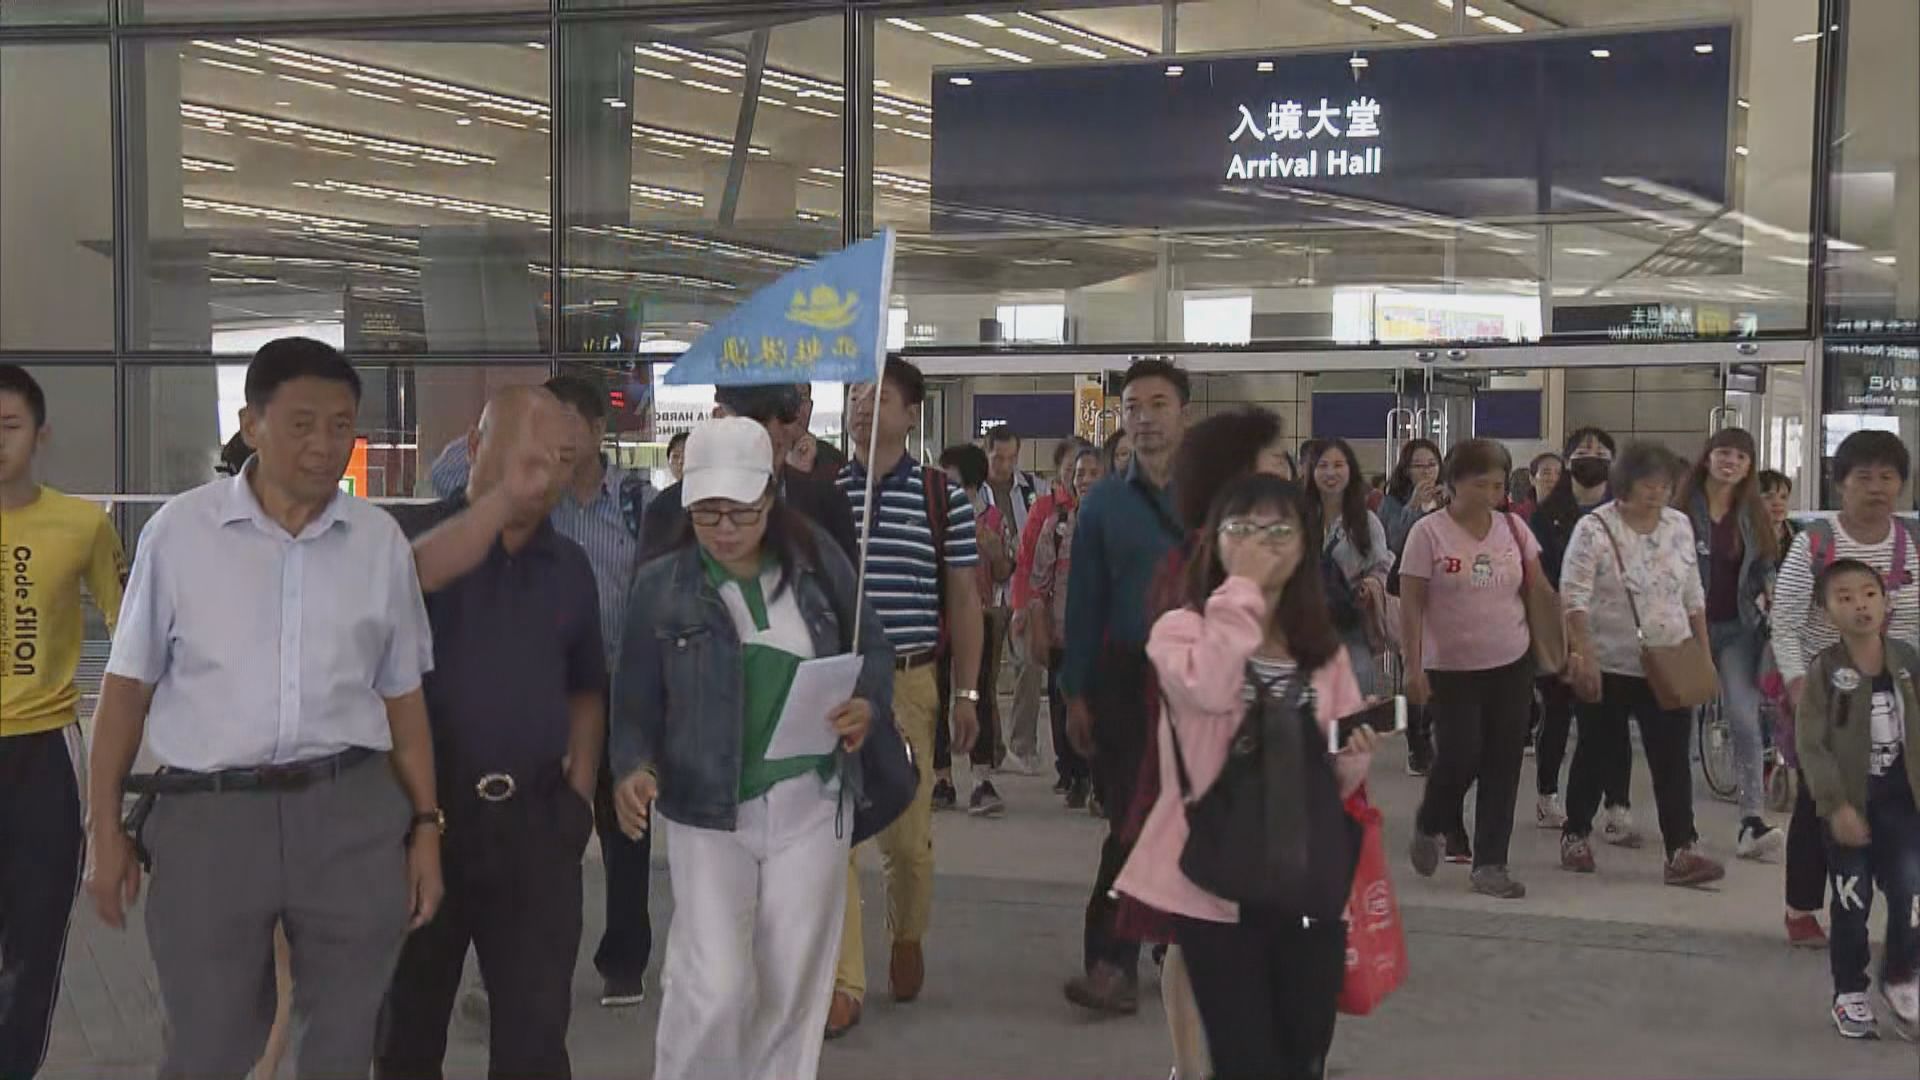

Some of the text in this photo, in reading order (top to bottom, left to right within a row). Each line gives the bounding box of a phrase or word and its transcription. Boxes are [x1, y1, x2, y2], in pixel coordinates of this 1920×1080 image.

[1228, 96, 1381, 142] 入境大堂
[1226, 147, 1382, 179] Arrival Hall
[13, 546, 34, 600] Code
[1835, 874, 1865, 911] K
